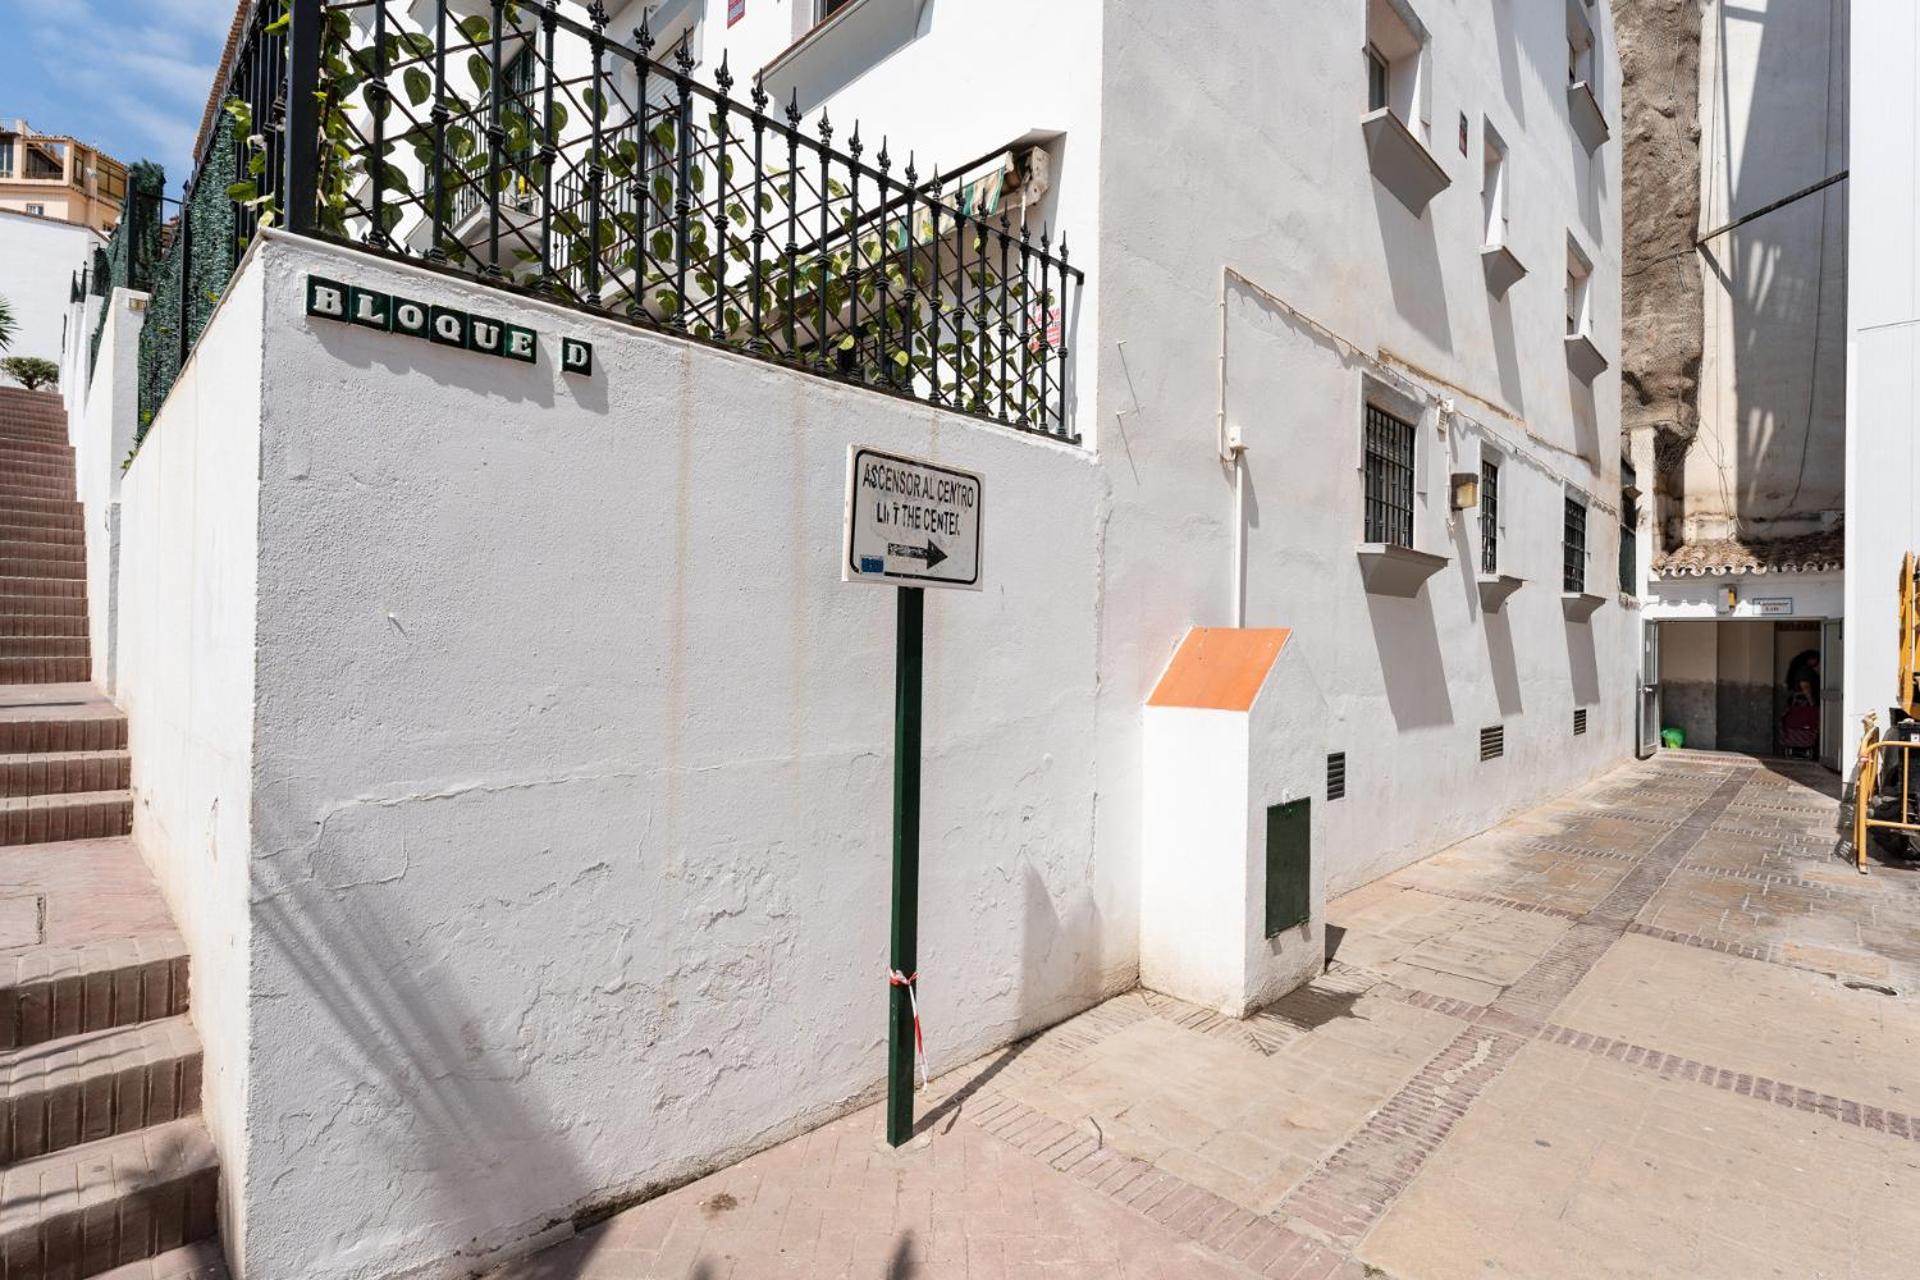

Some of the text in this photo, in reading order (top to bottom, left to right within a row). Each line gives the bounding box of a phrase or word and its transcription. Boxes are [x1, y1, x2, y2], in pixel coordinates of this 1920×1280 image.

[313, 285, 588, 367] BLOQUE D
[863, 463, 974, 509] ASCENSOR AL CENTRO
[902, 504, 921, 529] THE
